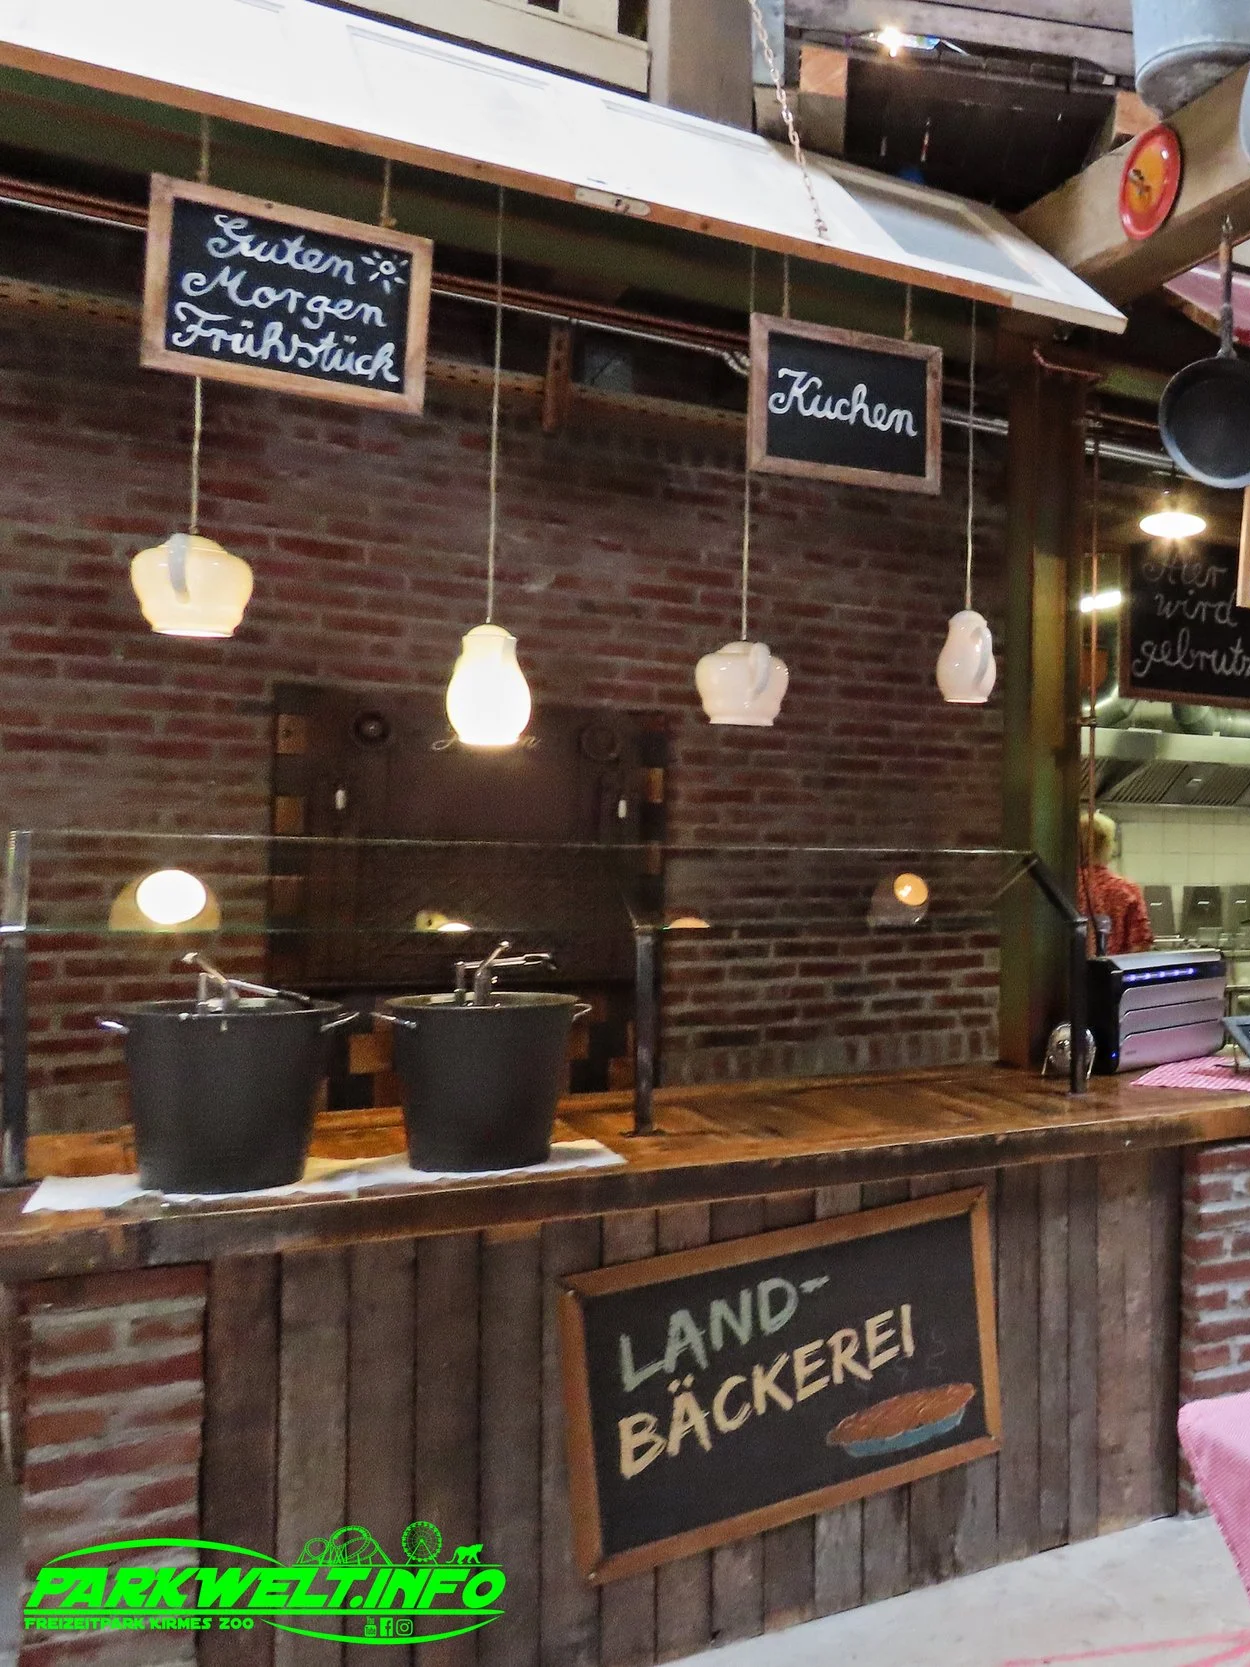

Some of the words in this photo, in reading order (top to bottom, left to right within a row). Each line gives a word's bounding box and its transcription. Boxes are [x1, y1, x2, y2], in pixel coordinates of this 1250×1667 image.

[206, 214, 356, 285] Guten
[181, 265, 387, 329] Morgen
[172, 302, 400, 383] Frühstück
[768, 367, 918, 437] Kuchen
[1155, 588, 1238, 627] wird
[618, 1274, 830, 1393] LAND-
[617, 1303, 916, 1479] BÄCKEREI
